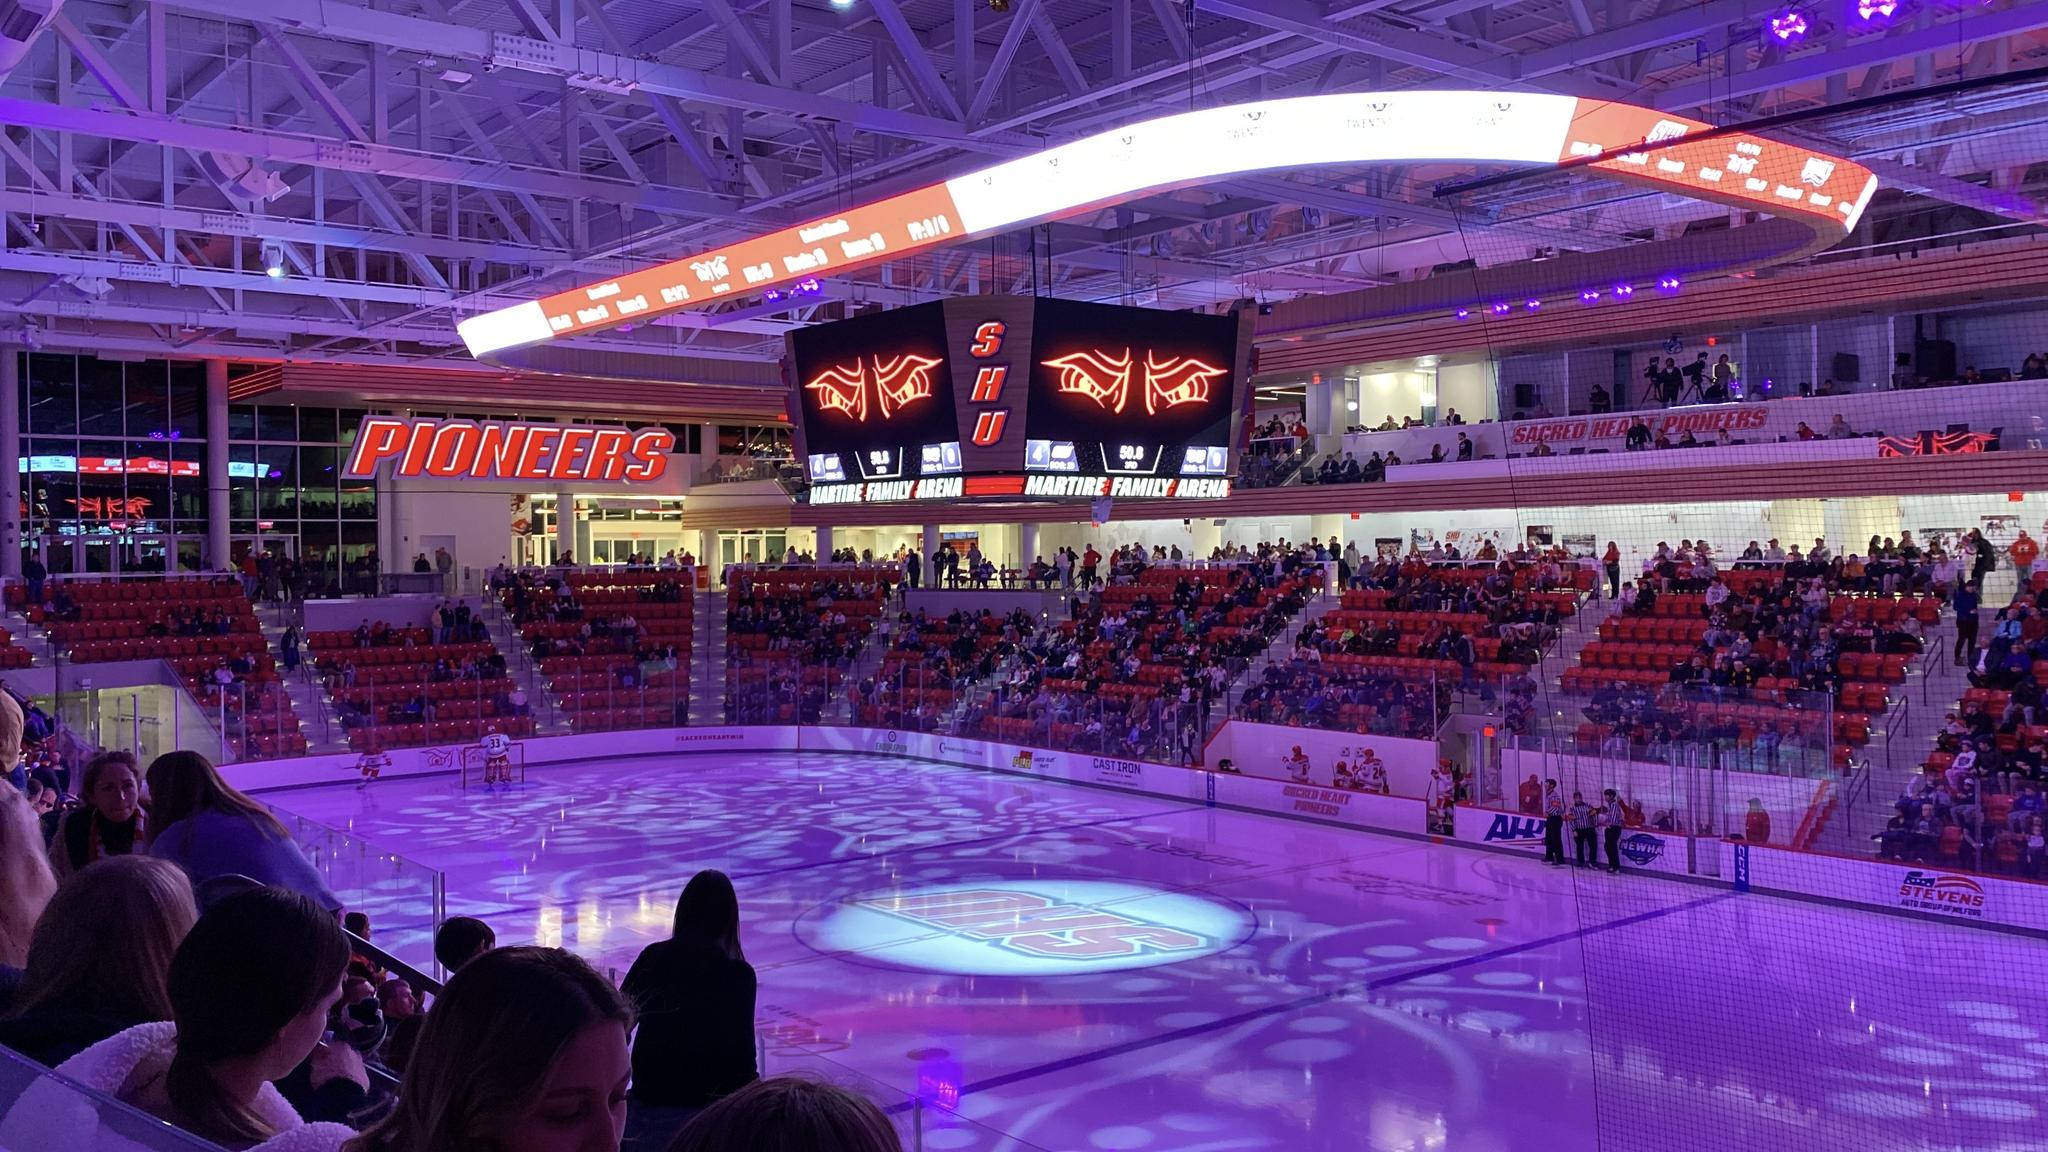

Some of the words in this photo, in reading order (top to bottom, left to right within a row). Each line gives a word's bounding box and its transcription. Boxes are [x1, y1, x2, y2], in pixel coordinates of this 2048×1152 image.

[1512, 420, 1588, 444] SACRED
[1590, 415, 1661, 438] HEAT
[1662, 407, 1769, 435] PIONEERS
[350, 418, 676, 481] PIONEERS
[810, 483, 864, 504] MARTIRE
[866, 480, 914, 501] FAMILY
[914, 477, 962, 498] ARENA
[1024, 475, 1108, 496] MARTIRE
[1109, 477, 1172, 496] FAMILY
[1174, 478, 1230, 497] ARENA
[490, 738, 500, 749] 33
[1093, 757, 1116, 771] CAST
[1117, 761, 1142, 775] IRON
[1620, 838, 1665, 856] NEWHA
[1738, 844, 1746, 882] CCM
[1900, 885, 1984, 907] STEVENS
